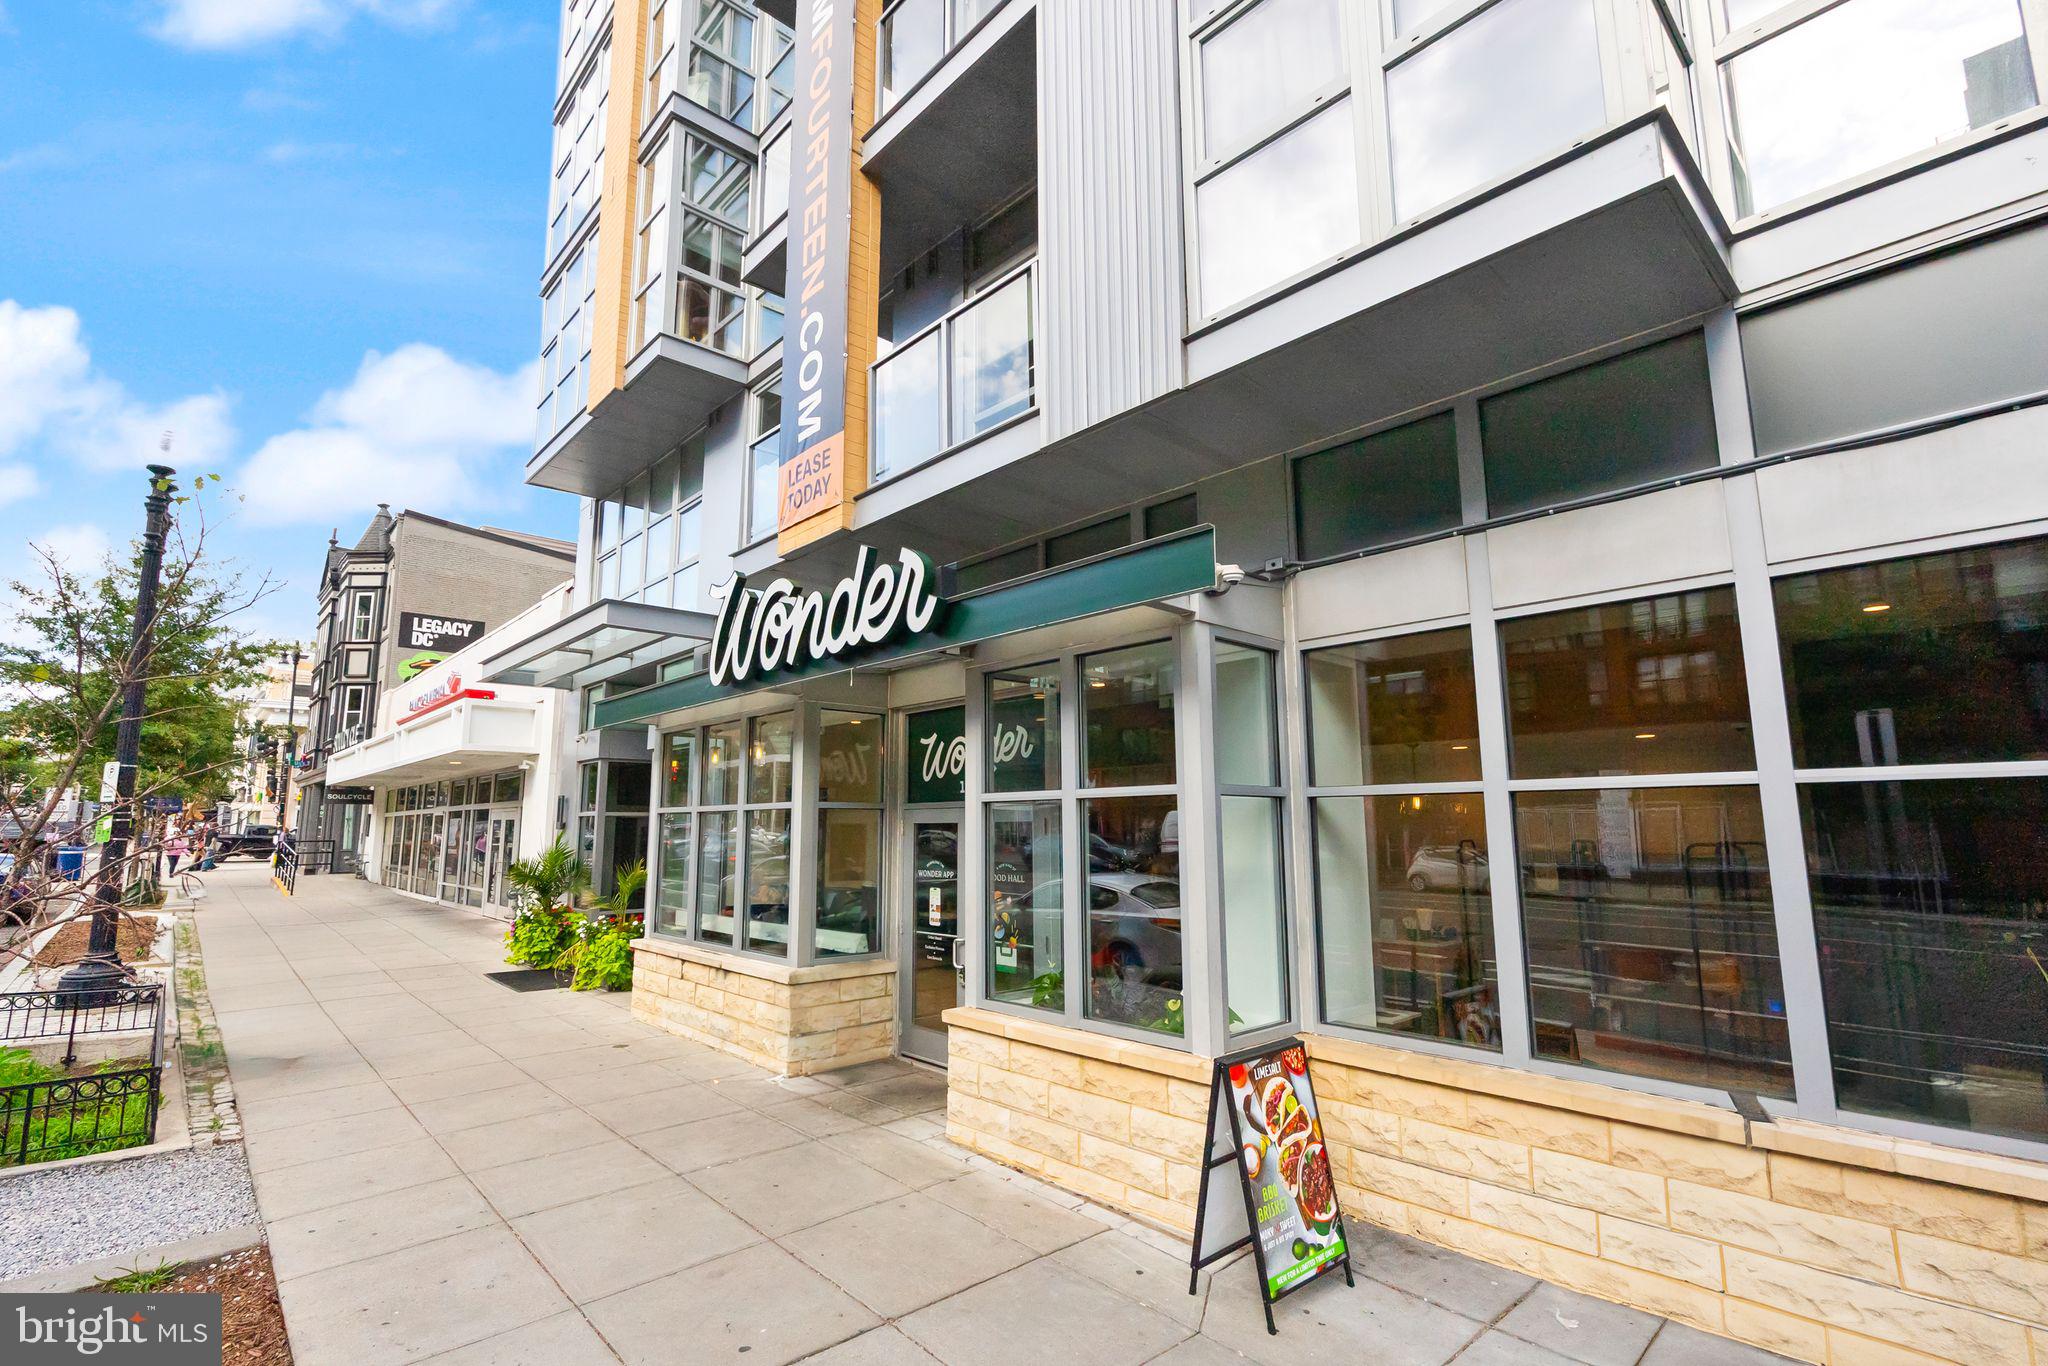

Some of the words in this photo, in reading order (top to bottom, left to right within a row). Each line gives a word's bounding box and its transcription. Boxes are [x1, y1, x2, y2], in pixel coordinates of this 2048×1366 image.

[788, 448, 831, 488] LEASE
[788, 473, 832, 512] TODAY
[412, 617, 473, 637] LEGACY
[709, 544, 940, 687] Wonder
[920, 722, 1034, 782] Woder
[917, 869, 942, 878] WONDER
[942, 871, 955, 879] APP
[1007, 875, 1025, 883] HALL
[1254, 1061, 1282, 1080] LIMESALT
[1262, 1183, 1279, 1202] BBQ
[1257, 1196, 1288, 1223] BRISKET
